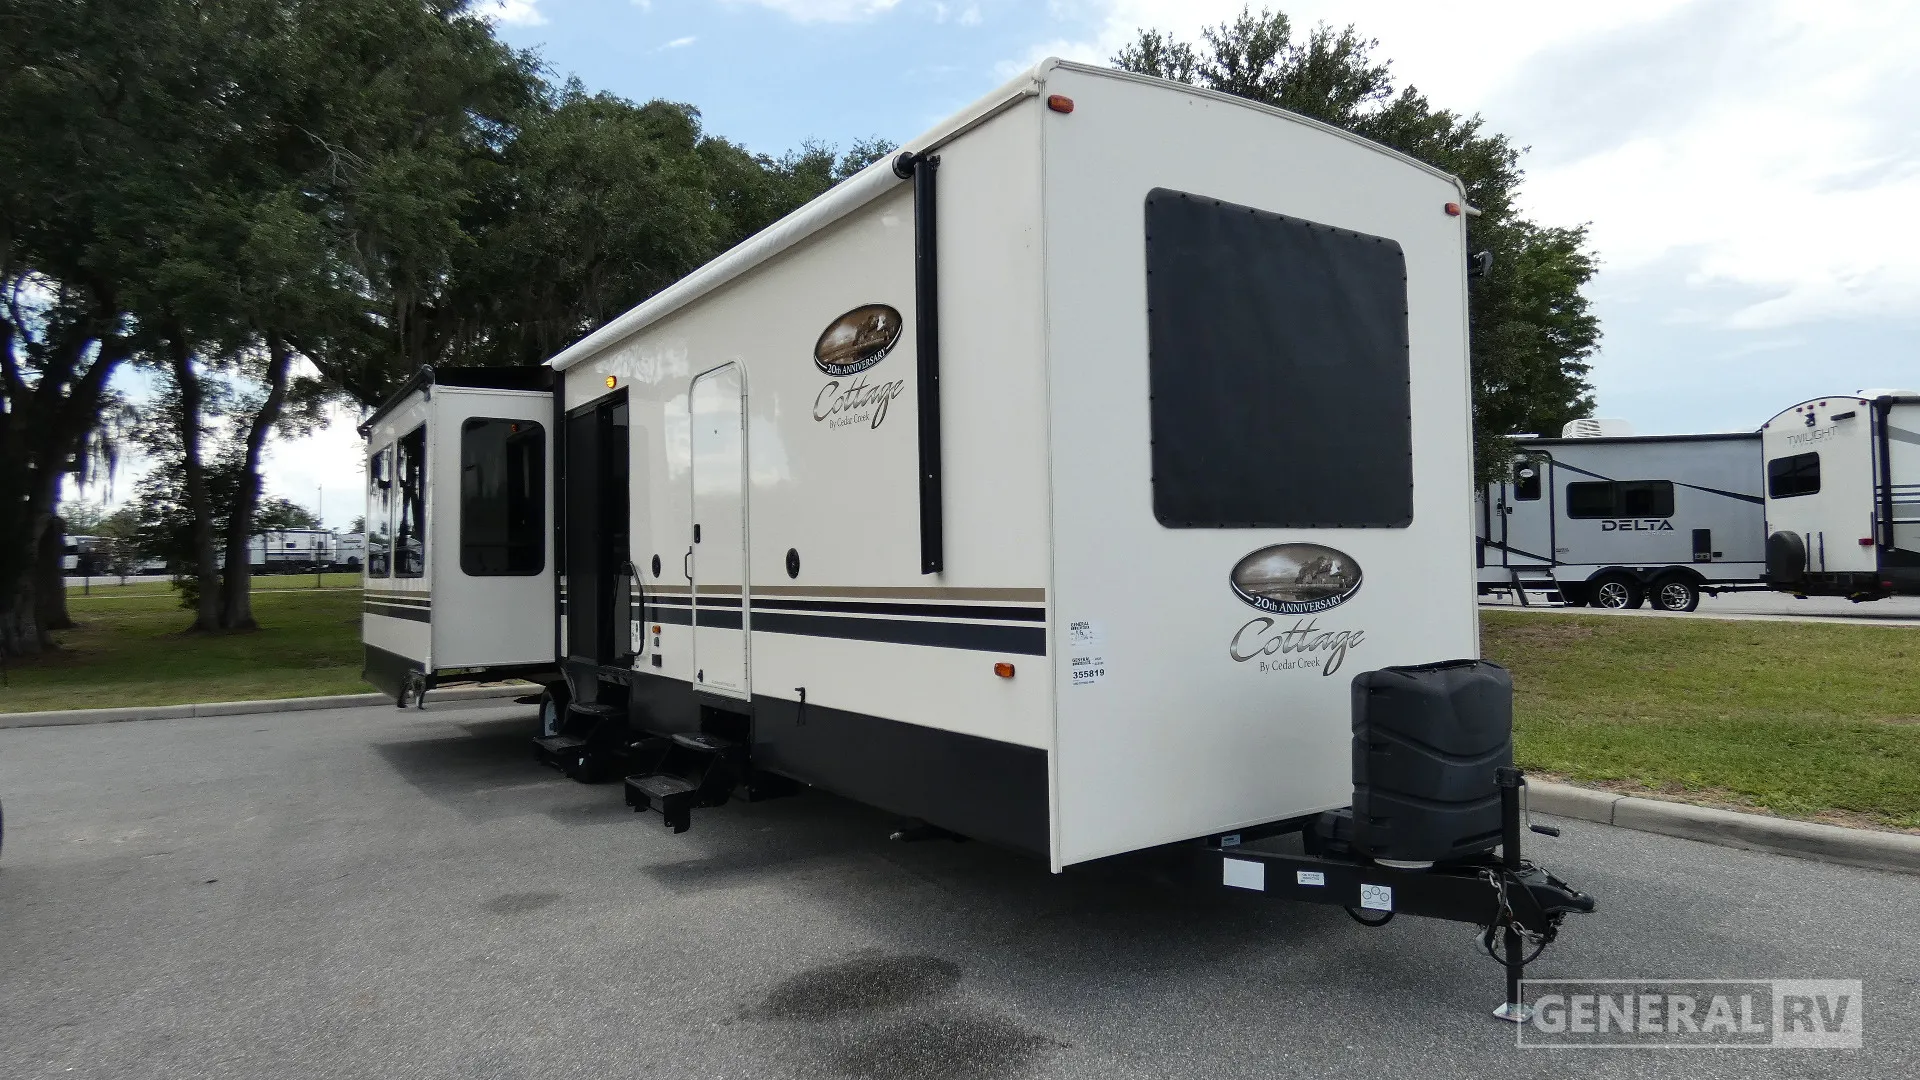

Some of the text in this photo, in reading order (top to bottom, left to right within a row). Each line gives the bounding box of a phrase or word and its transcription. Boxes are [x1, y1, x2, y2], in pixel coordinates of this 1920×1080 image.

[827, 347, 887, 374] 20th ANNIVERSARY
[813, 375, 904, 429] Cottage
[829, 411, 870, 430] By Cedar Creek
[1786, 425, 1838, 445] TWILIGHT
[1602, 519, 1675, 531] DELTA
[1254, 594, 1343, 613] 20th ANNIVERSARY
[1229, 616, 1366, 677] Cottage
[1072, 668, 1105, 679] 355819
[1259, 656, 1321, 674] By Cedar Creek
